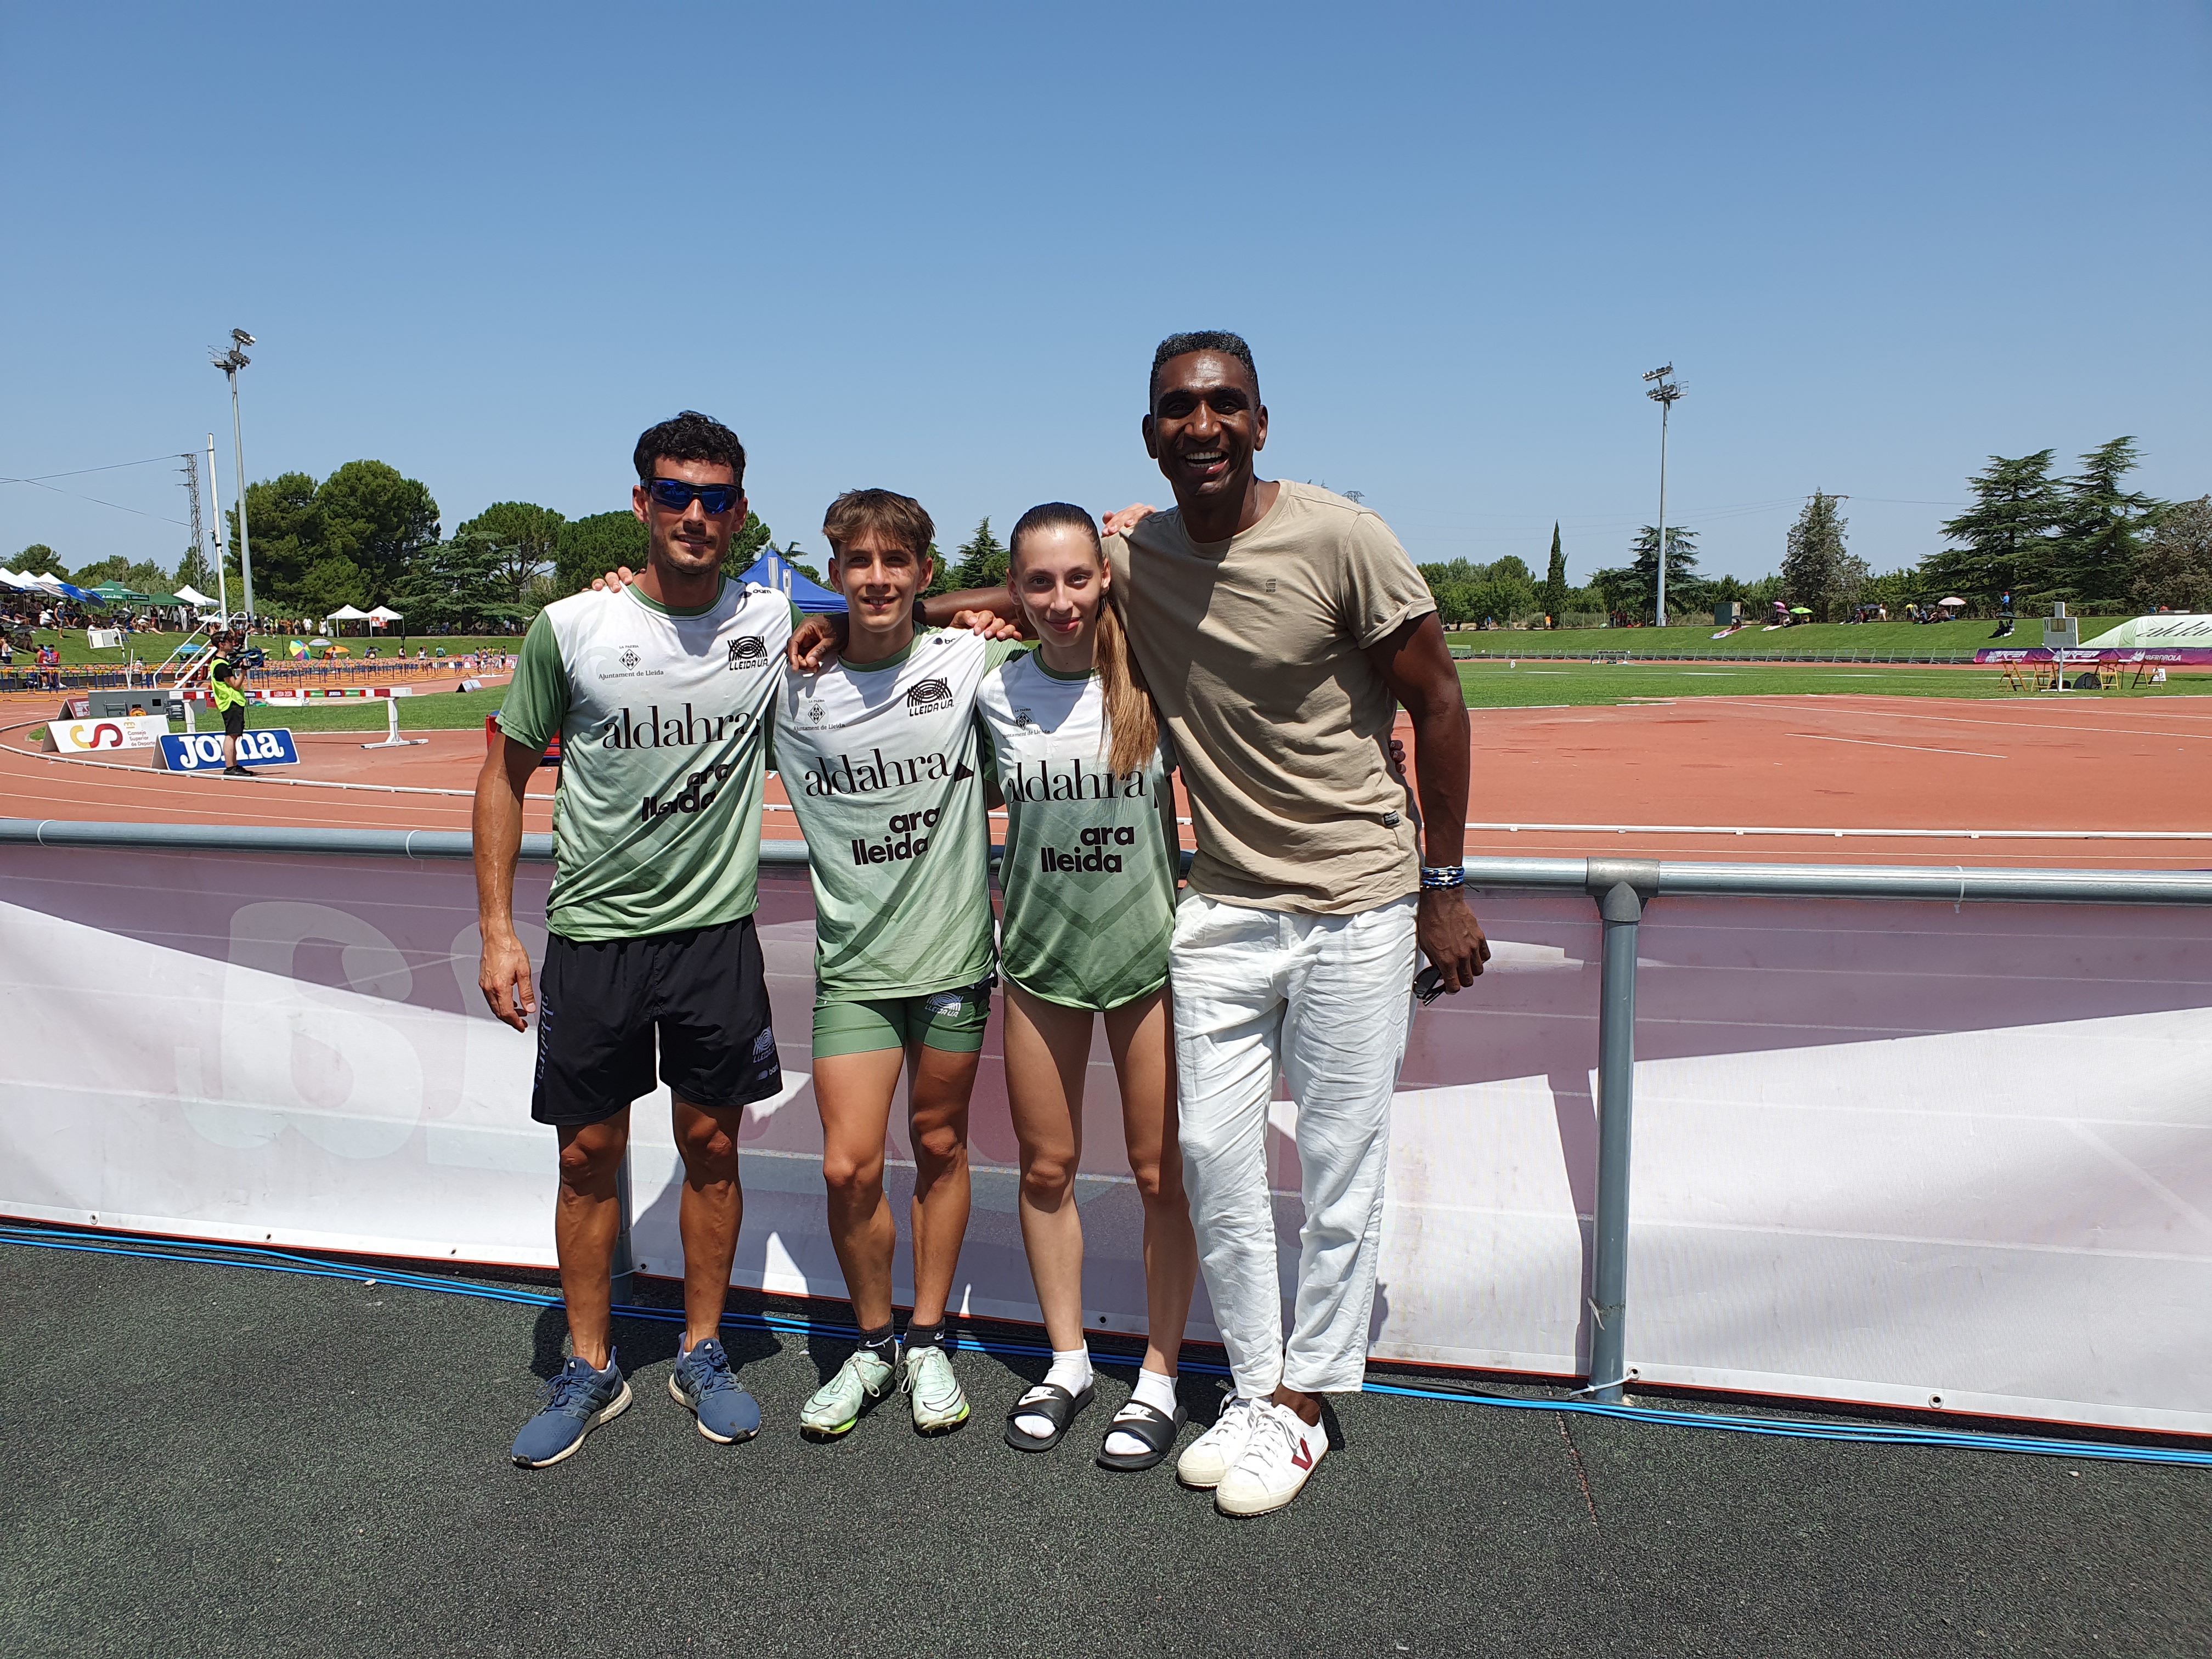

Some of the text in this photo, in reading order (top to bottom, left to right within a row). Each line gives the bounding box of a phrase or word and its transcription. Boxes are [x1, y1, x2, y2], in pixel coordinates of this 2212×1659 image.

[598, 672, 635, 681] Ajuntament
[729, 660, 757, 671] LLEIDA
[909, 702, 939, 717] LLEIDA
[602, 702, 754, 750] aldahra
[686, 764, 732, 788] ara
[804, 748, 952, 797] aldahra
[642, 783, 716, 822] lleida
[889, 806, 941, 834] ara
[1080, 826, 1135, 847] ara
[851, 833, 929, 866] lleida
[1041, 845, 1122, 873] lleida
[924, 1004, 947, 1015] LLEIDA
[1026, 1386, 1056, 1399] NIKE
[1120, 1403, 1153, 1417] NIKE
